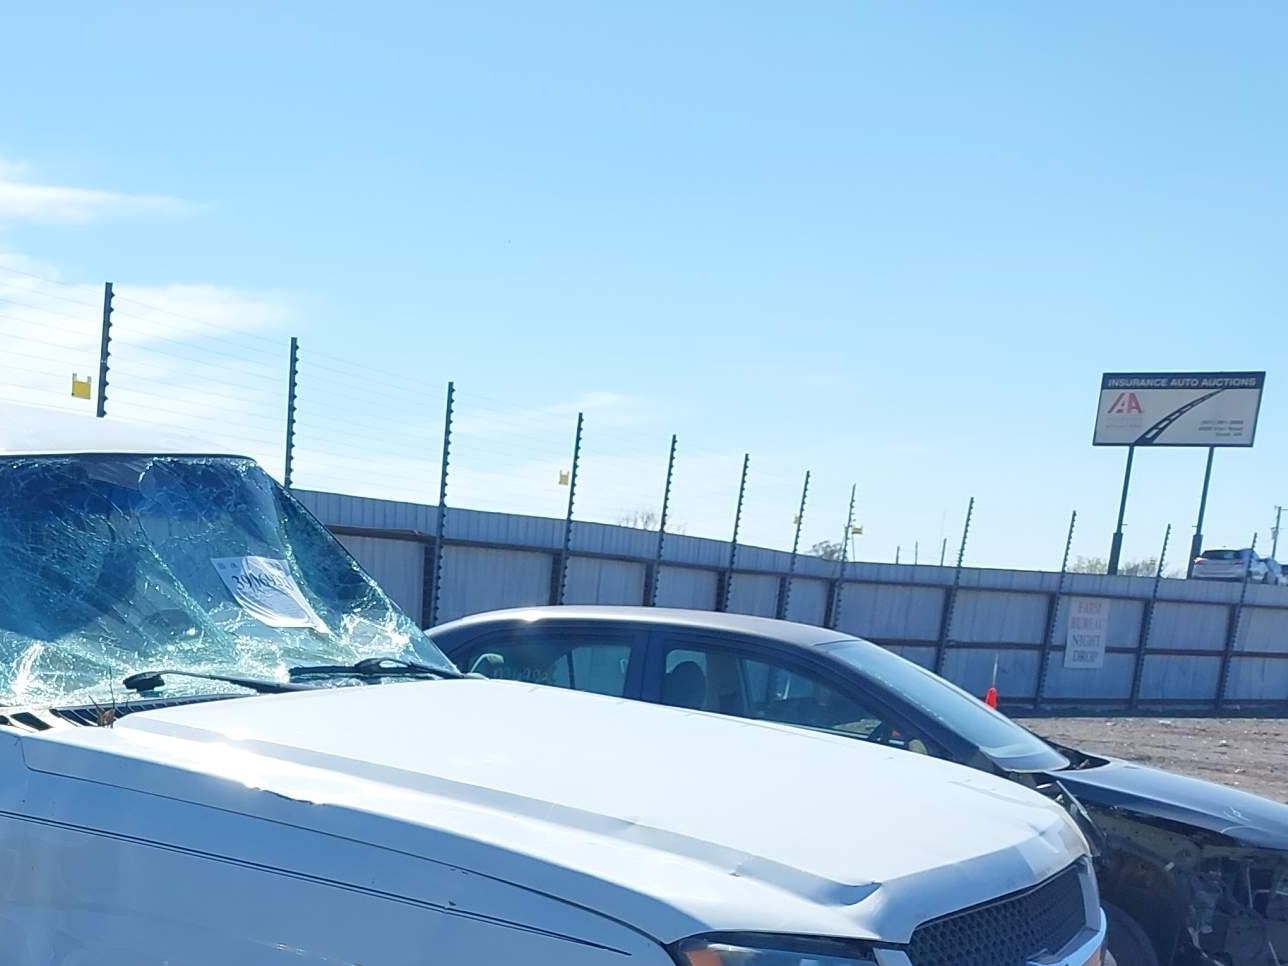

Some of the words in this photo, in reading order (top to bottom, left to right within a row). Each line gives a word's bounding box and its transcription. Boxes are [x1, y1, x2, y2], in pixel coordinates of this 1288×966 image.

[1107, 378, 1168, 387] INSURANCE
[1169, 378, 1199, 387] AUTO
[1201, 377, 1257, 386] AUCTIONS
[1072, 633, 1101, 648] NIGHT
[1072, 650, 1098, 663] DROP
